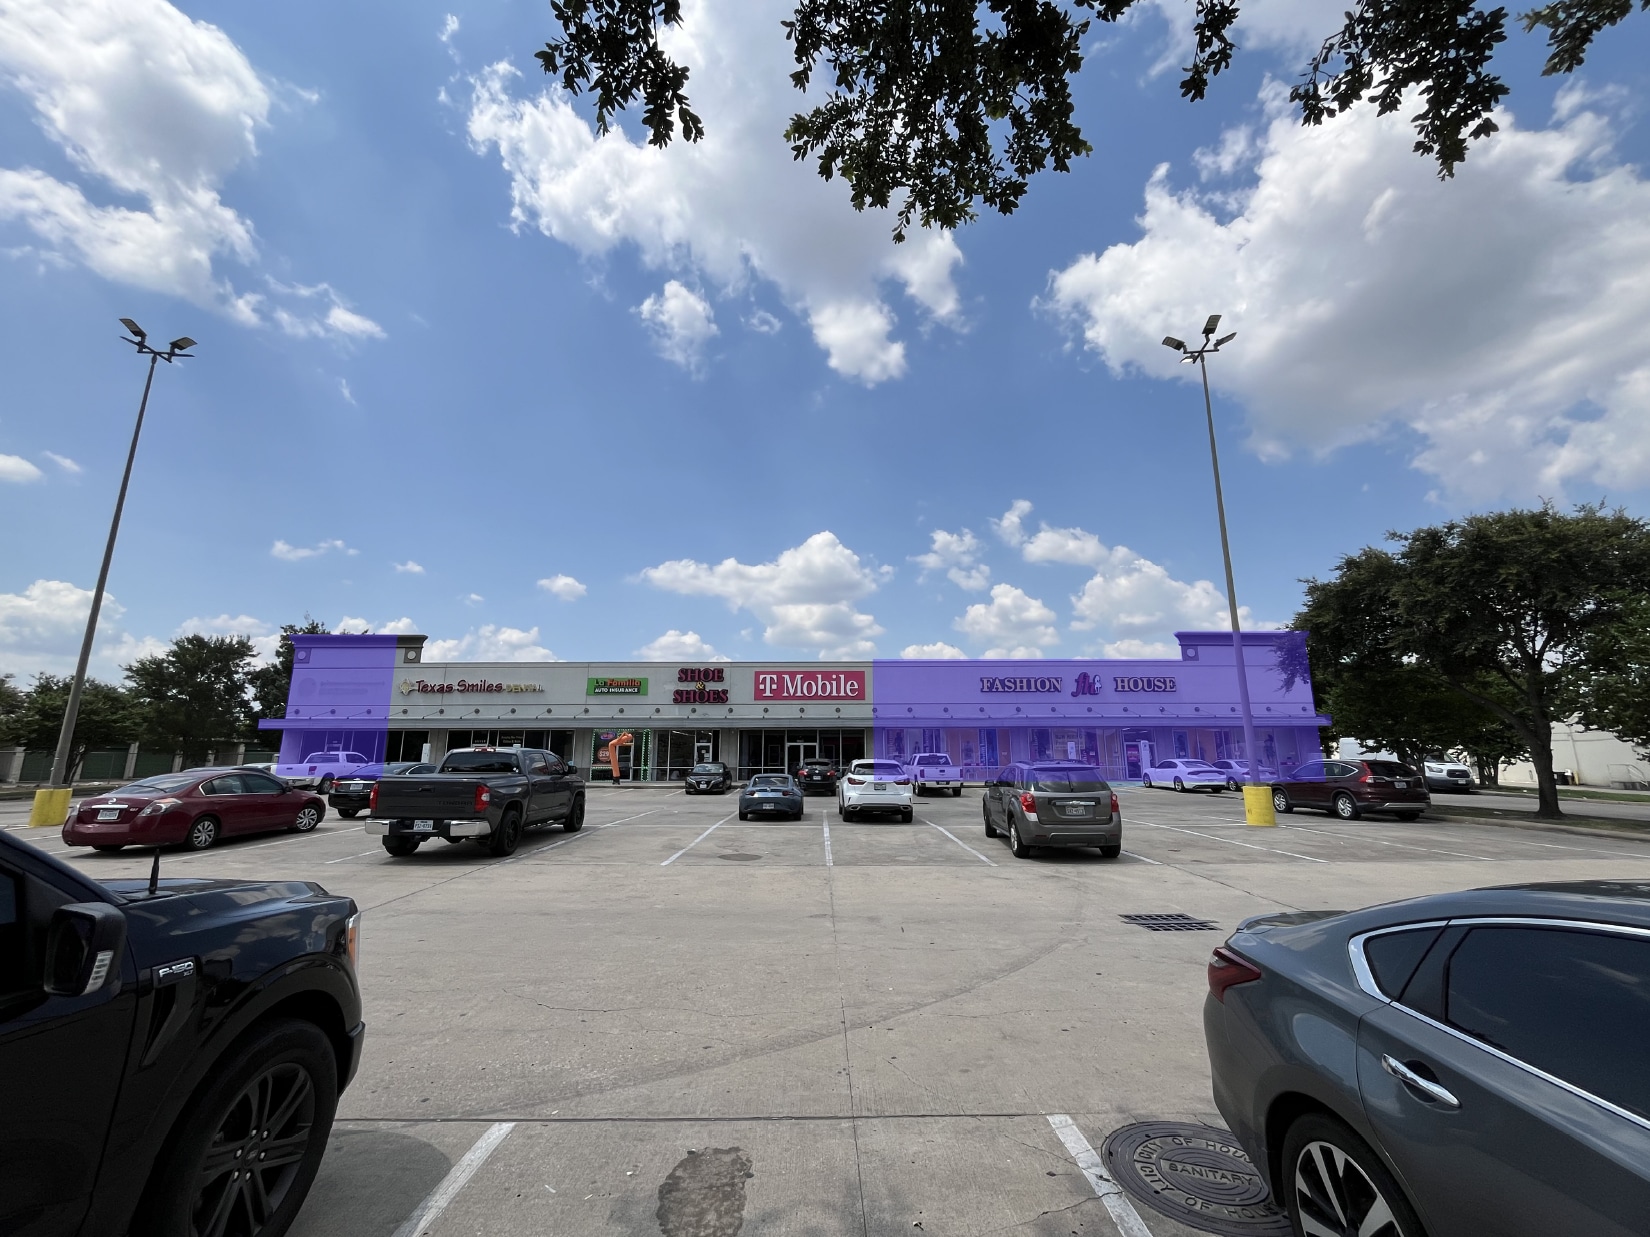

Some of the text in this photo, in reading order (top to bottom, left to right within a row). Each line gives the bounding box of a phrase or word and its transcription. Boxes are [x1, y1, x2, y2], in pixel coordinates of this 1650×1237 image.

[607, 678, 641, 687] Familia
[677, 667, 724, 683] SHOE
[415, 679, 454, 694] Texas
[457, 679, 504, 694] Smiles
[695, 681, 706, 691] &
[782, 674, 859, 697] Mobile
[980, 676, 1063, 693] FASHION
[1114, 676, 1177, 693] HOUSE
[672, 688, 728, 704] SHOES
[1138, 1141, 1164, 1159] CITY
[1172, 1137, 1195, 1147] OF
[1168, 1163, 1253, 1186] SANITARY
[1140, 1166, 1176, 1194] CITY
[1185, 1197, 1213, 1211] OF
